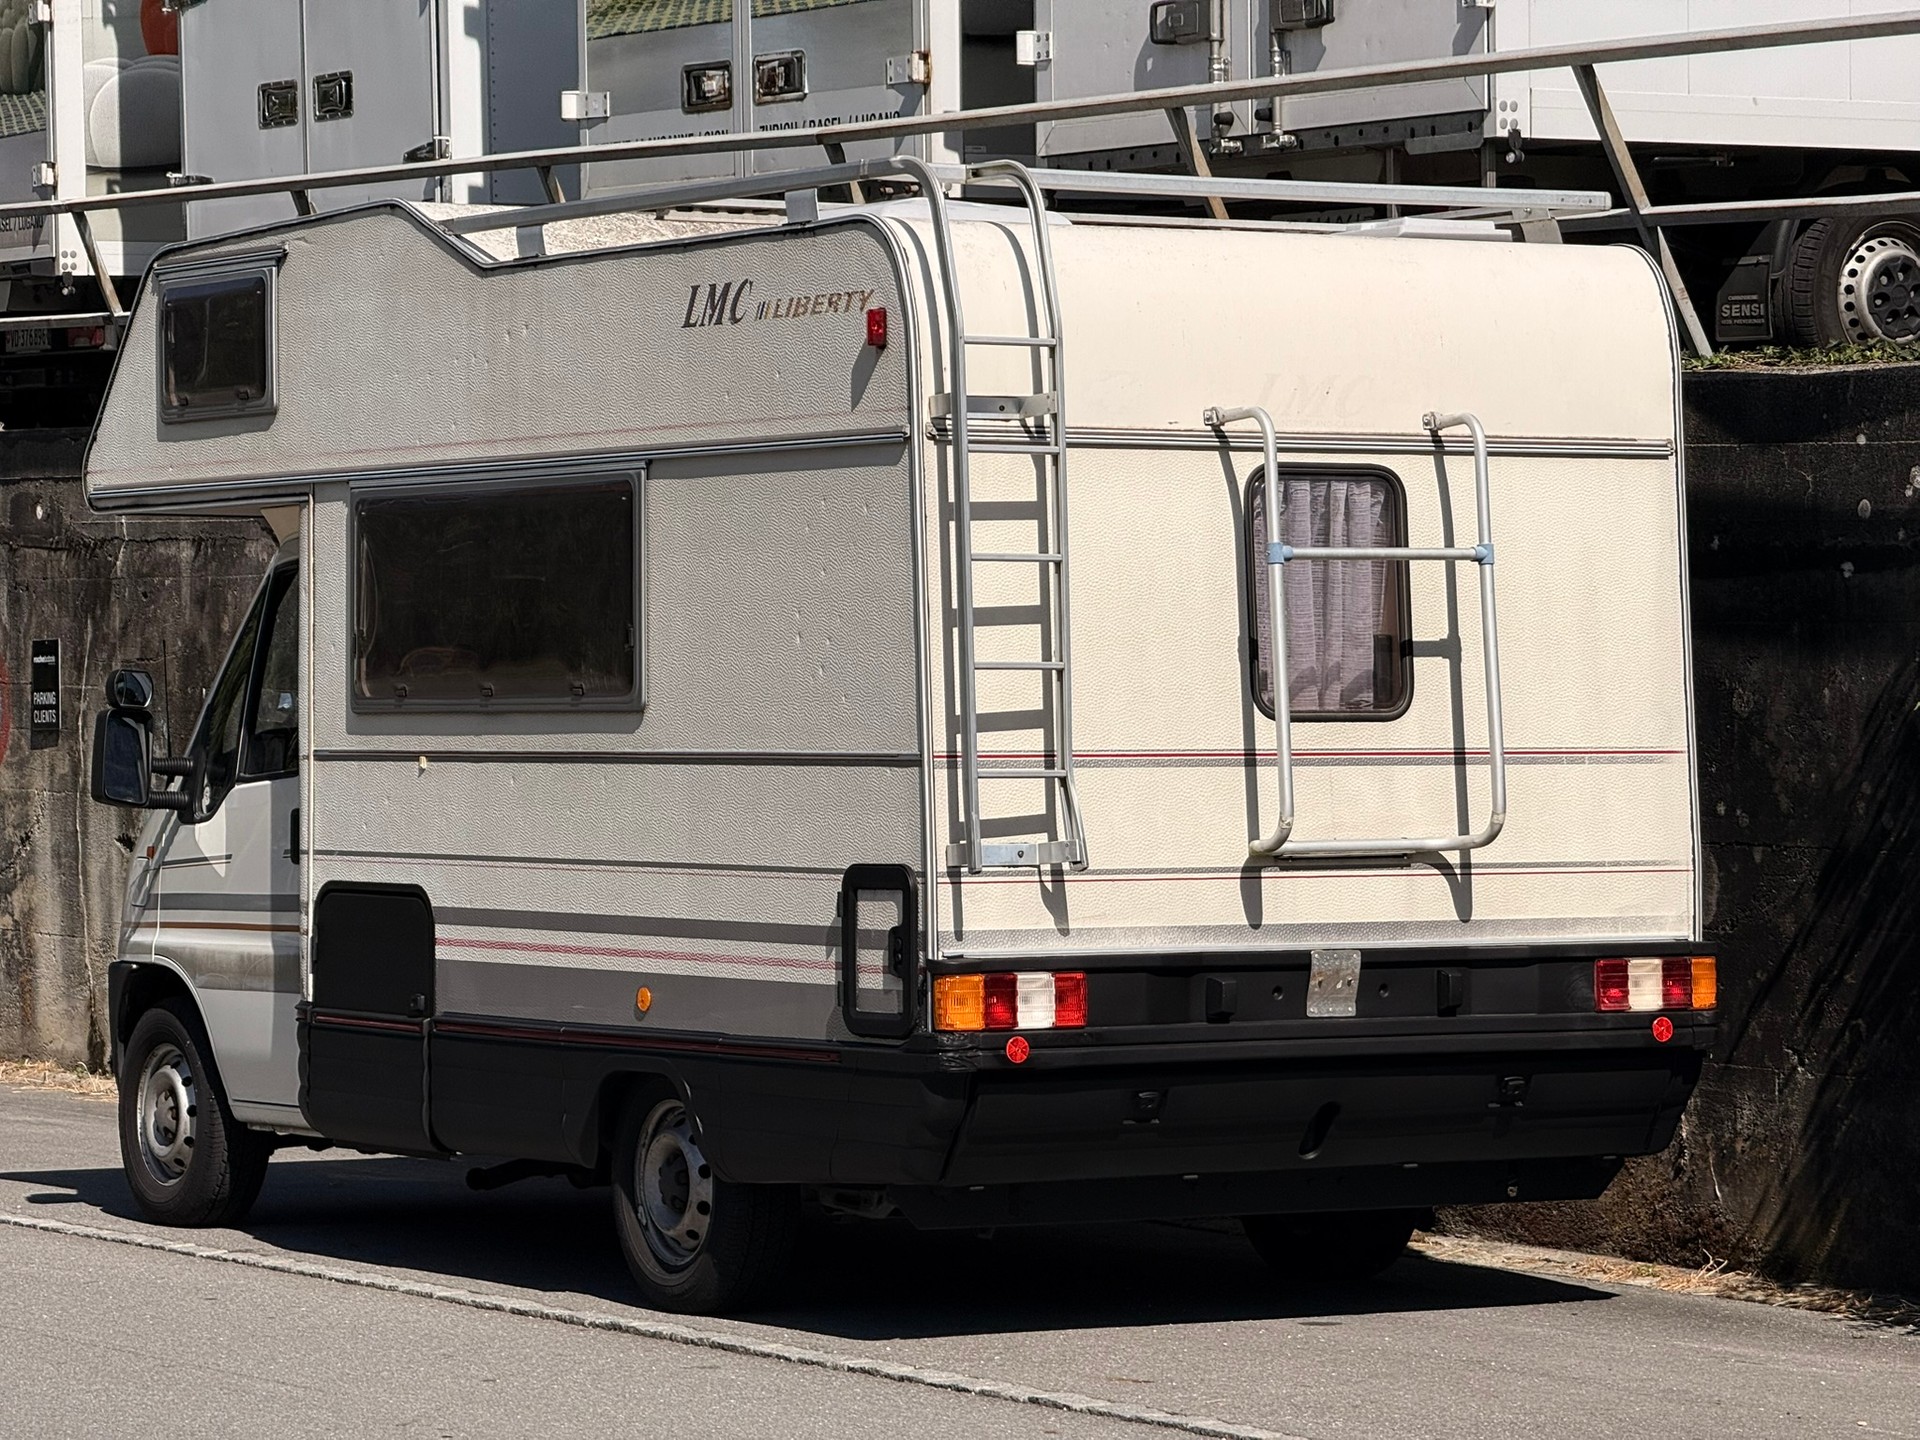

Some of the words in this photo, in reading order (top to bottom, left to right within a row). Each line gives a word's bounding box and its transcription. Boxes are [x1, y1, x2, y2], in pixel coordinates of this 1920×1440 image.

[0, 216, 13, 232] SEL
[681, 278, 754, 328] LMC
[772, 289, 875, 319] LIBERTY
[1721, 303, 1766, 317] SENSI
[33, 691, 56, 705] PARKING
[33, 709, 56, 723] CLIENTS
